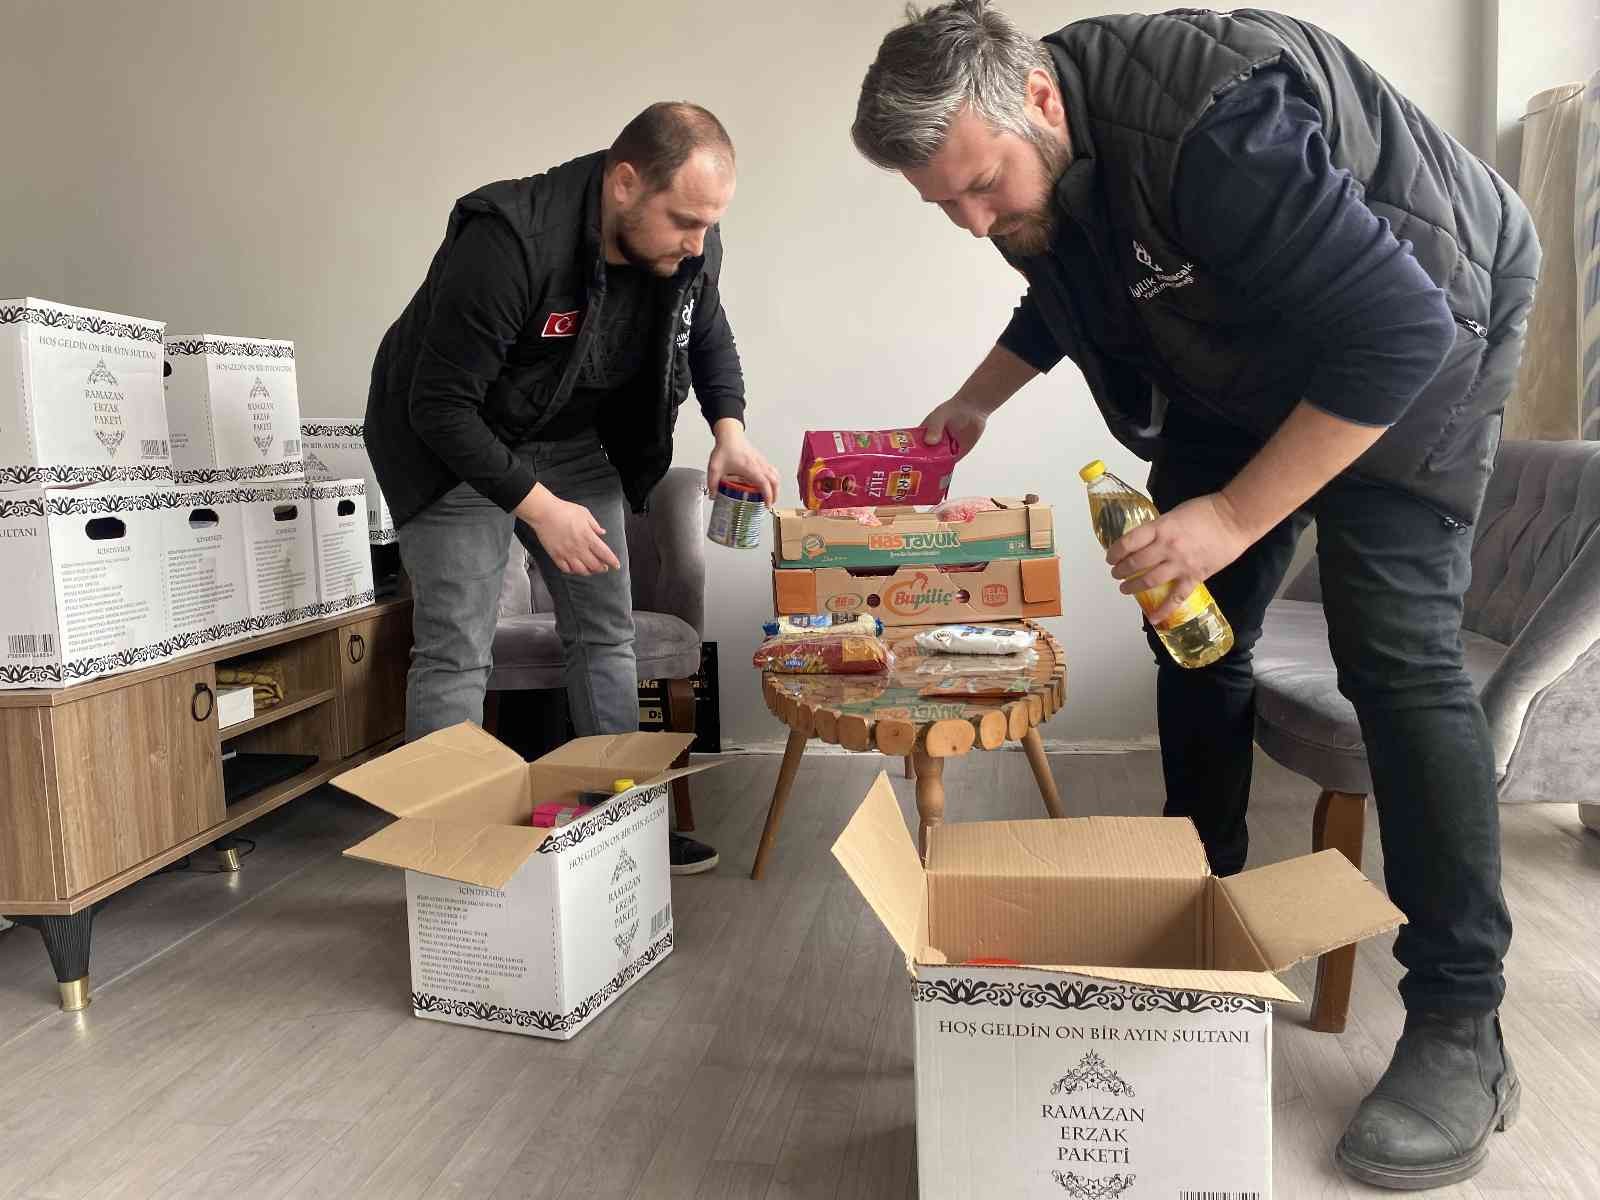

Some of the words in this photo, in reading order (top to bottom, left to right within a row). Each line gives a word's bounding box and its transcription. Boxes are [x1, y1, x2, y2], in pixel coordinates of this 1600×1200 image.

[85, 389, 124, 401] RAMAZAN
[868, 470, 885, 498] FİLİZ
[895, 464, 912, 501] DEREN
[608, 874, 641, 904] RAMAZAN
[938, 1020, 977, 1037] HOŞ
[981, 1022, 1050, 1038] GELDİN
[1055, 1026, 1084, 1039] ON
[1090, 1025, 1120, 1041] BİR
[1123, 1029, 1167, 1042] AYIN
[1172, 1029, 1250, 1043] SULTANI
[1041, 1103, 1145, 1123] RAMAZAN
[1060, 1126, 1128, 1144] ERZAK
[1057, 1147, 1130, 1165] PAKETİ
